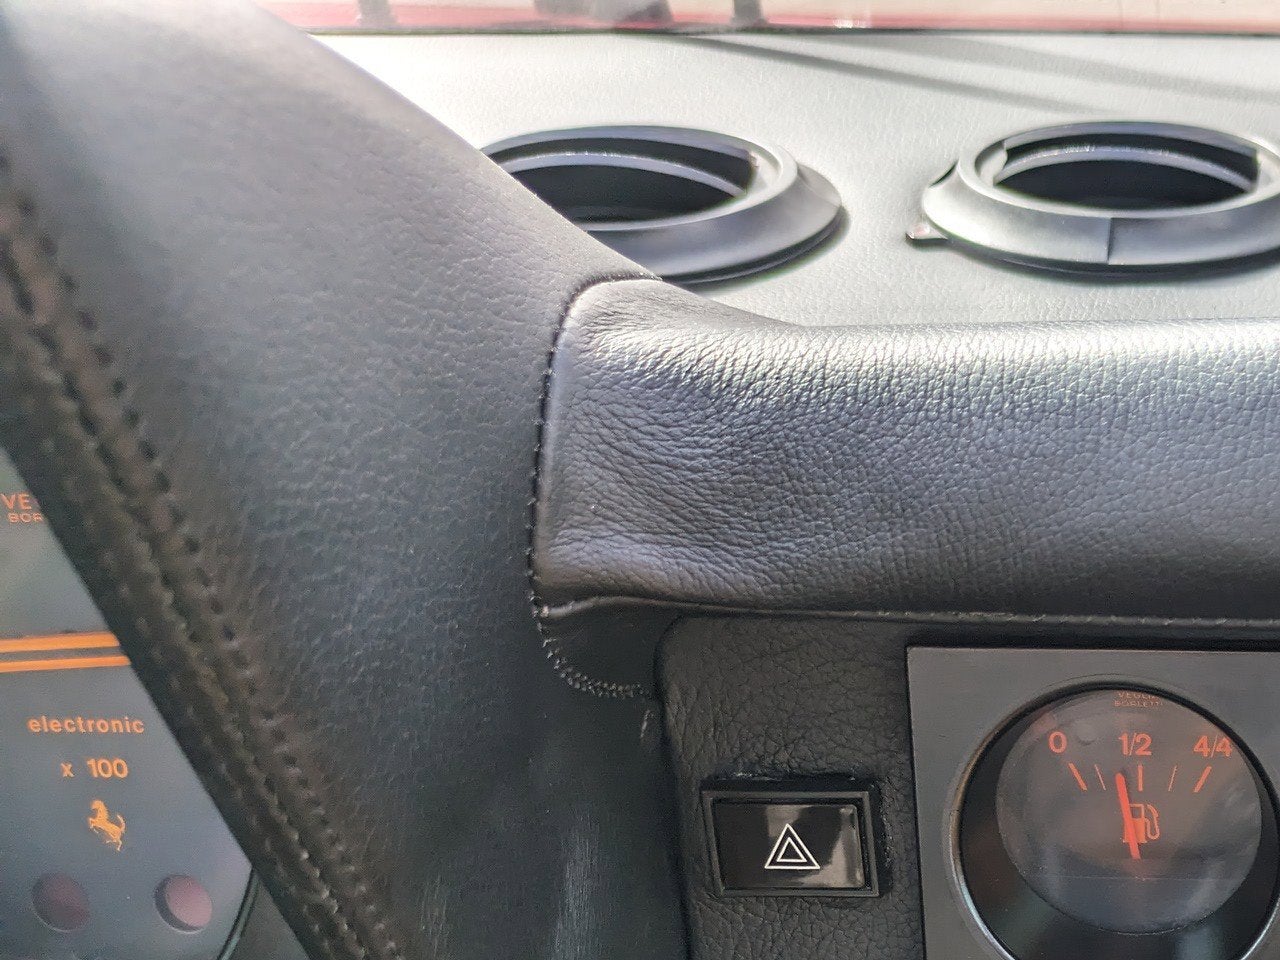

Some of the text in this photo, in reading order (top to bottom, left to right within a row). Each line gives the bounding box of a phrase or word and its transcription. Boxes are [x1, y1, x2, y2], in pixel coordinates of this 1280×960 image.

[0, 493, 32, 510] VE
[27, 715, 145, 733] electronic
[1049, 731, 1233, 757] 0 1/2 4/4
[60, 758, 129, 779] x 100
